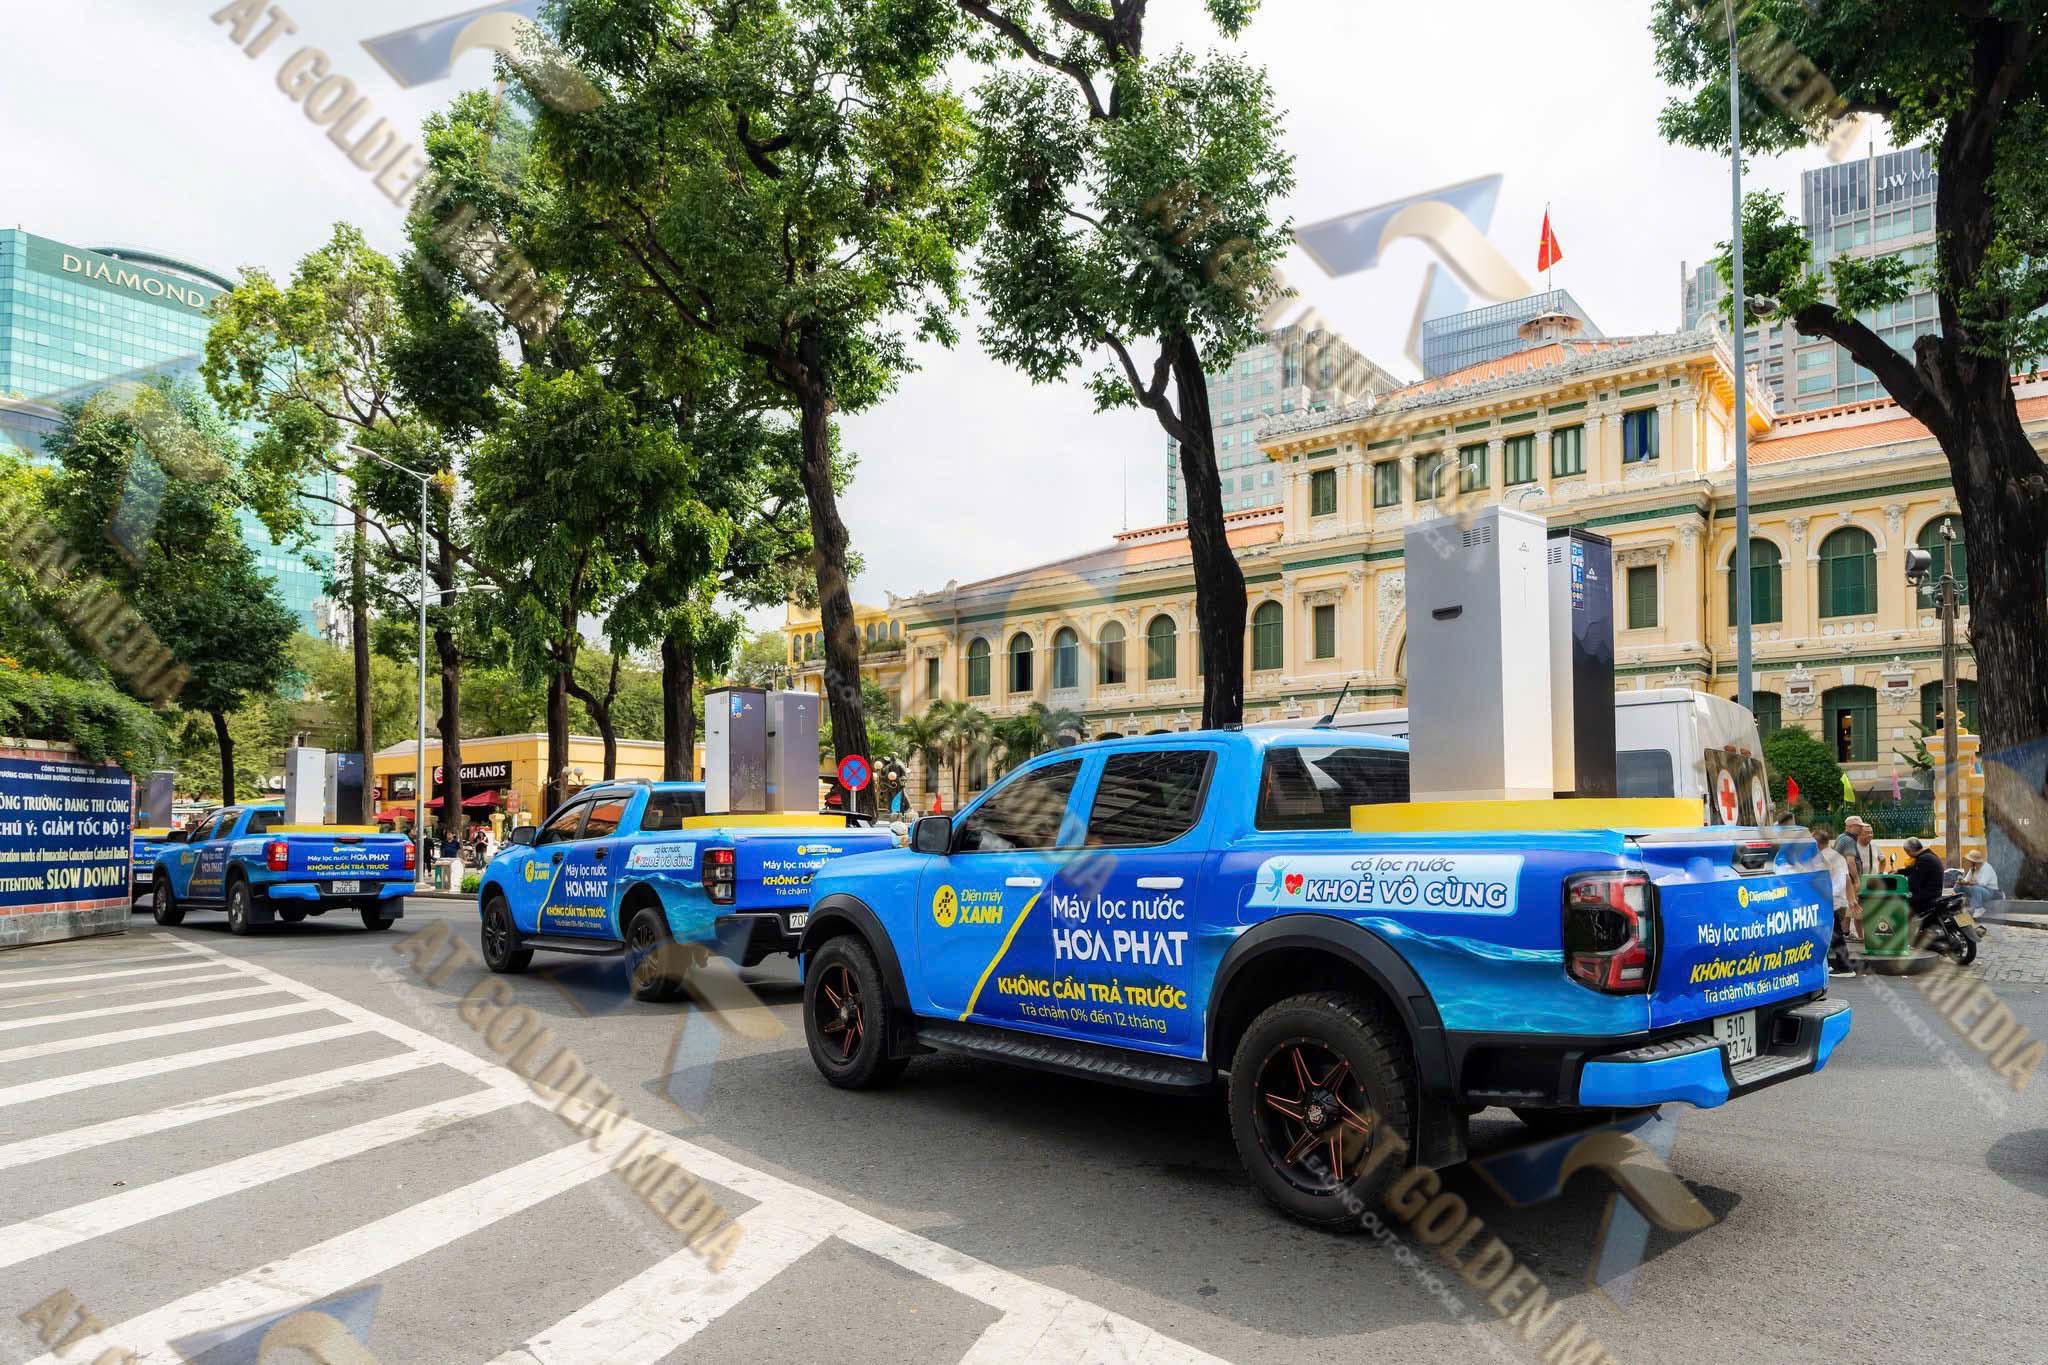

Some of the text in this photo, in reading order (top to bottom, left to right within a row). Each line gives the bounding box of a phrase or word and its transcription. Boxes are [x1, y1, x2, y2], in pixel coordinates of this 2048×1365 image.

[1878, 167, 1939, 191] JW MA
[61, 253, 206, 308] DIAMOND
[459, 764, 506, 780] GHLANDS
[0, 792, 129, 813] ÔNG TRƯỜNG ĐANG THI CÔNG
[42, 816, 73, 836] GIẢM
[77, 817, 100, 836] TỐC
[103, 818, 119, 838] ĐỘ
[566, 864, 578, 878] Máy
[579, 863, 590, 879] lọc
[763, 860, 781, 870] Máy
[783, 860, 797, 870] lọc
[1351, 857, 1456, 876] có lọc nước
[0, 877, 44, 892] TTENTION:
[47, 868, 81, 890] SLOW
[83, 866, 120, 888] DOWN
[763, 874, 799, 886] KHÔNG
[1305, 873, 1508, 907] KHOẺ VÔ CÙNG
[982, 887, 1004, 905] máy
[959, 905, 1004, 924] XANH
[1053, 893, 1186, 925] Máy lọc nước
[1698, 923, 1721, 947] Máy
[1723, 922, 1740, 946] lọc
[1741, 920, 1766, 940] nước
[1689, 940, 1815, 984] KHÔNG CẦN TRẢ TRƯỚC
[997, 974, 1188, 1010] KHÔNG CẦN TRẢ TRƯỚC
[1704, 986, 1719, 1004] Trả
[1719, 984, 1744, 1003] chậm
[1018, 1002, 1168, 1034] Trả chậm 0% đến 12 tháng
